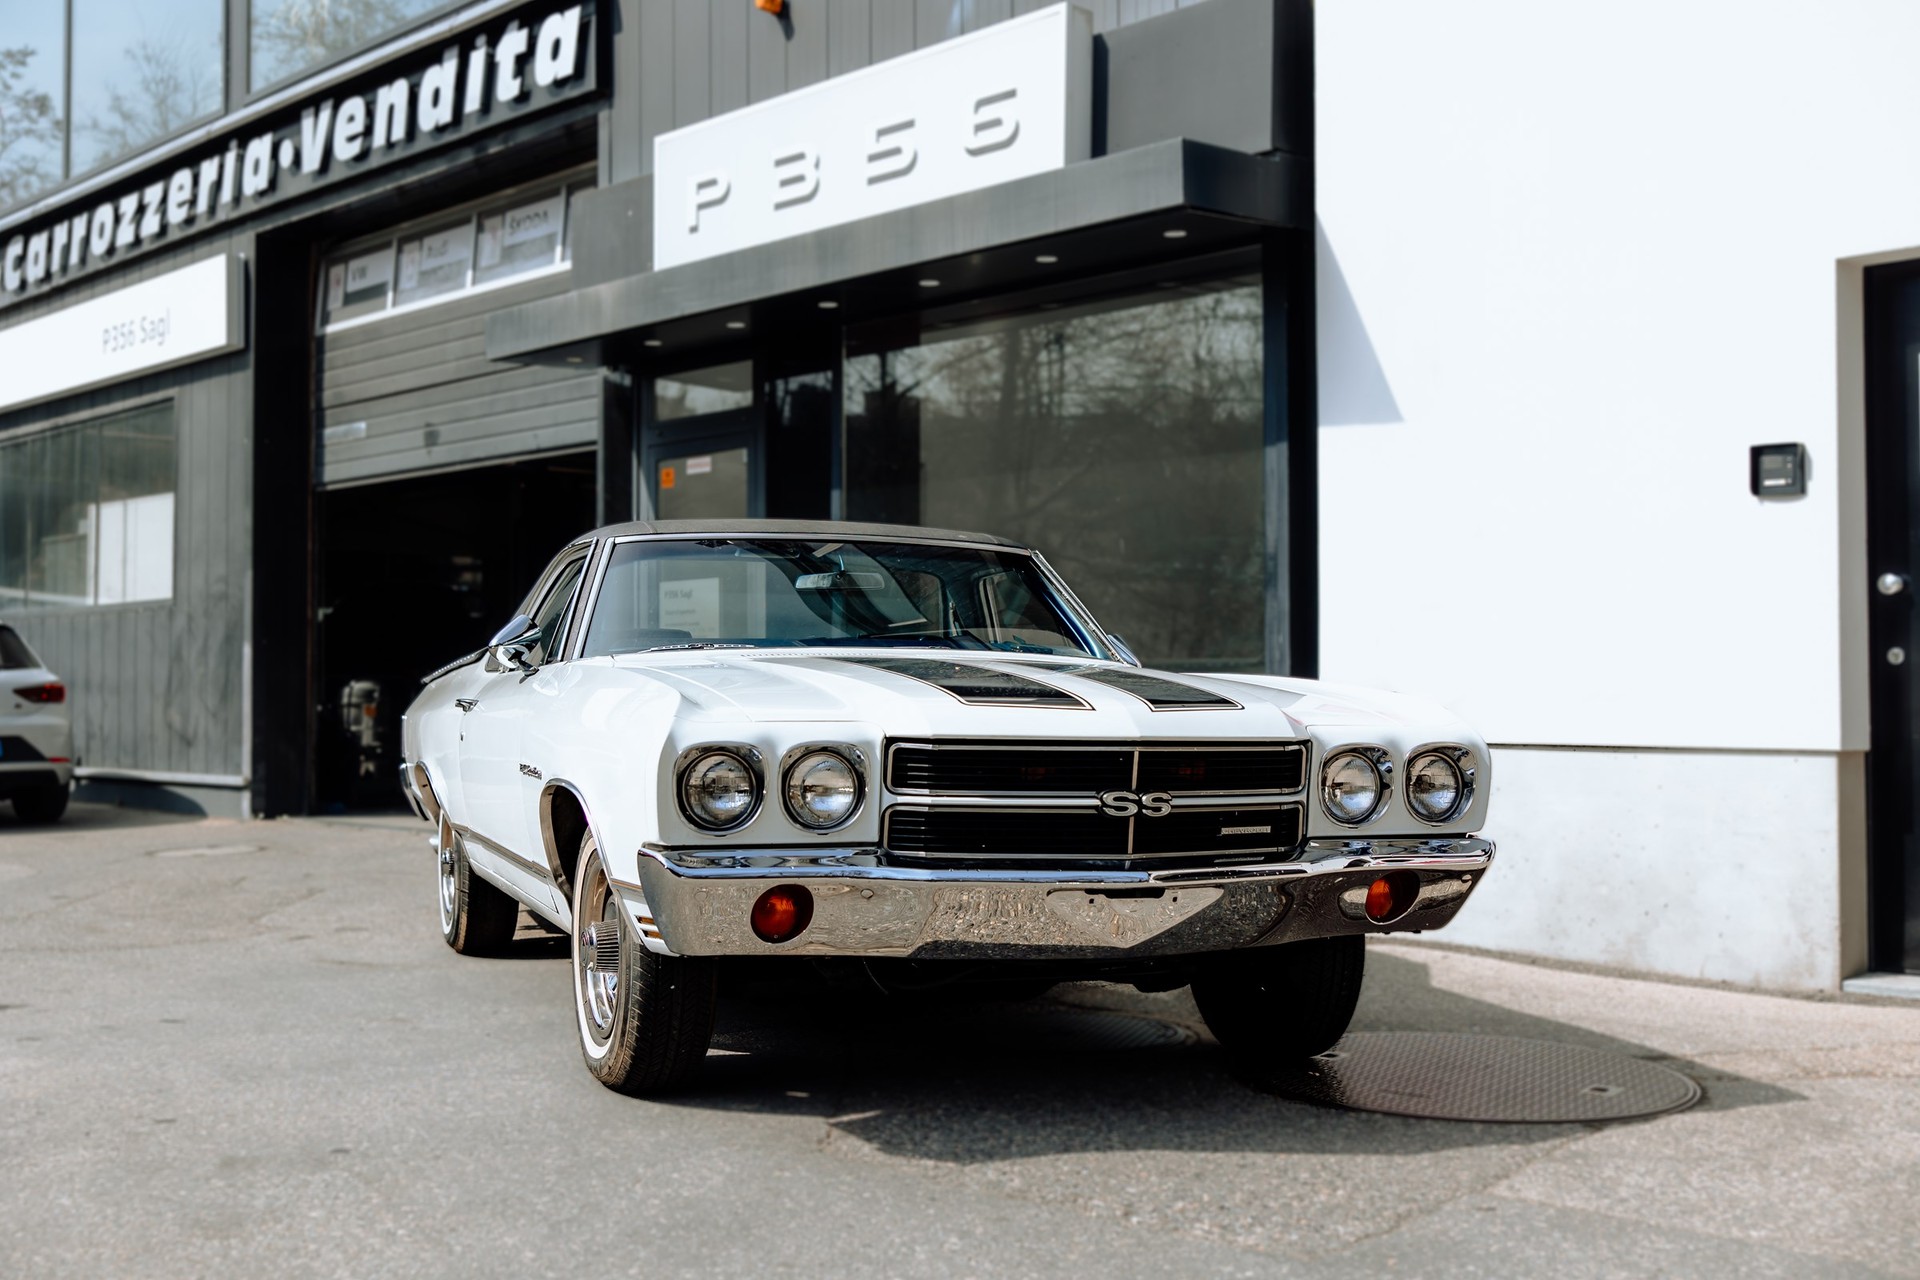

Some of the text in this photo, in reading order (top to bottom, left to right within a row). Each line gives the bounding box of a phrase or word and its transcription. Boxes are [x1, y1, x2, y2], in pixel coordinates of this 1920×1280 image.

[102, 306, 170, 354] P356 Sagl
[1101, 790, 1172, 817] SS
